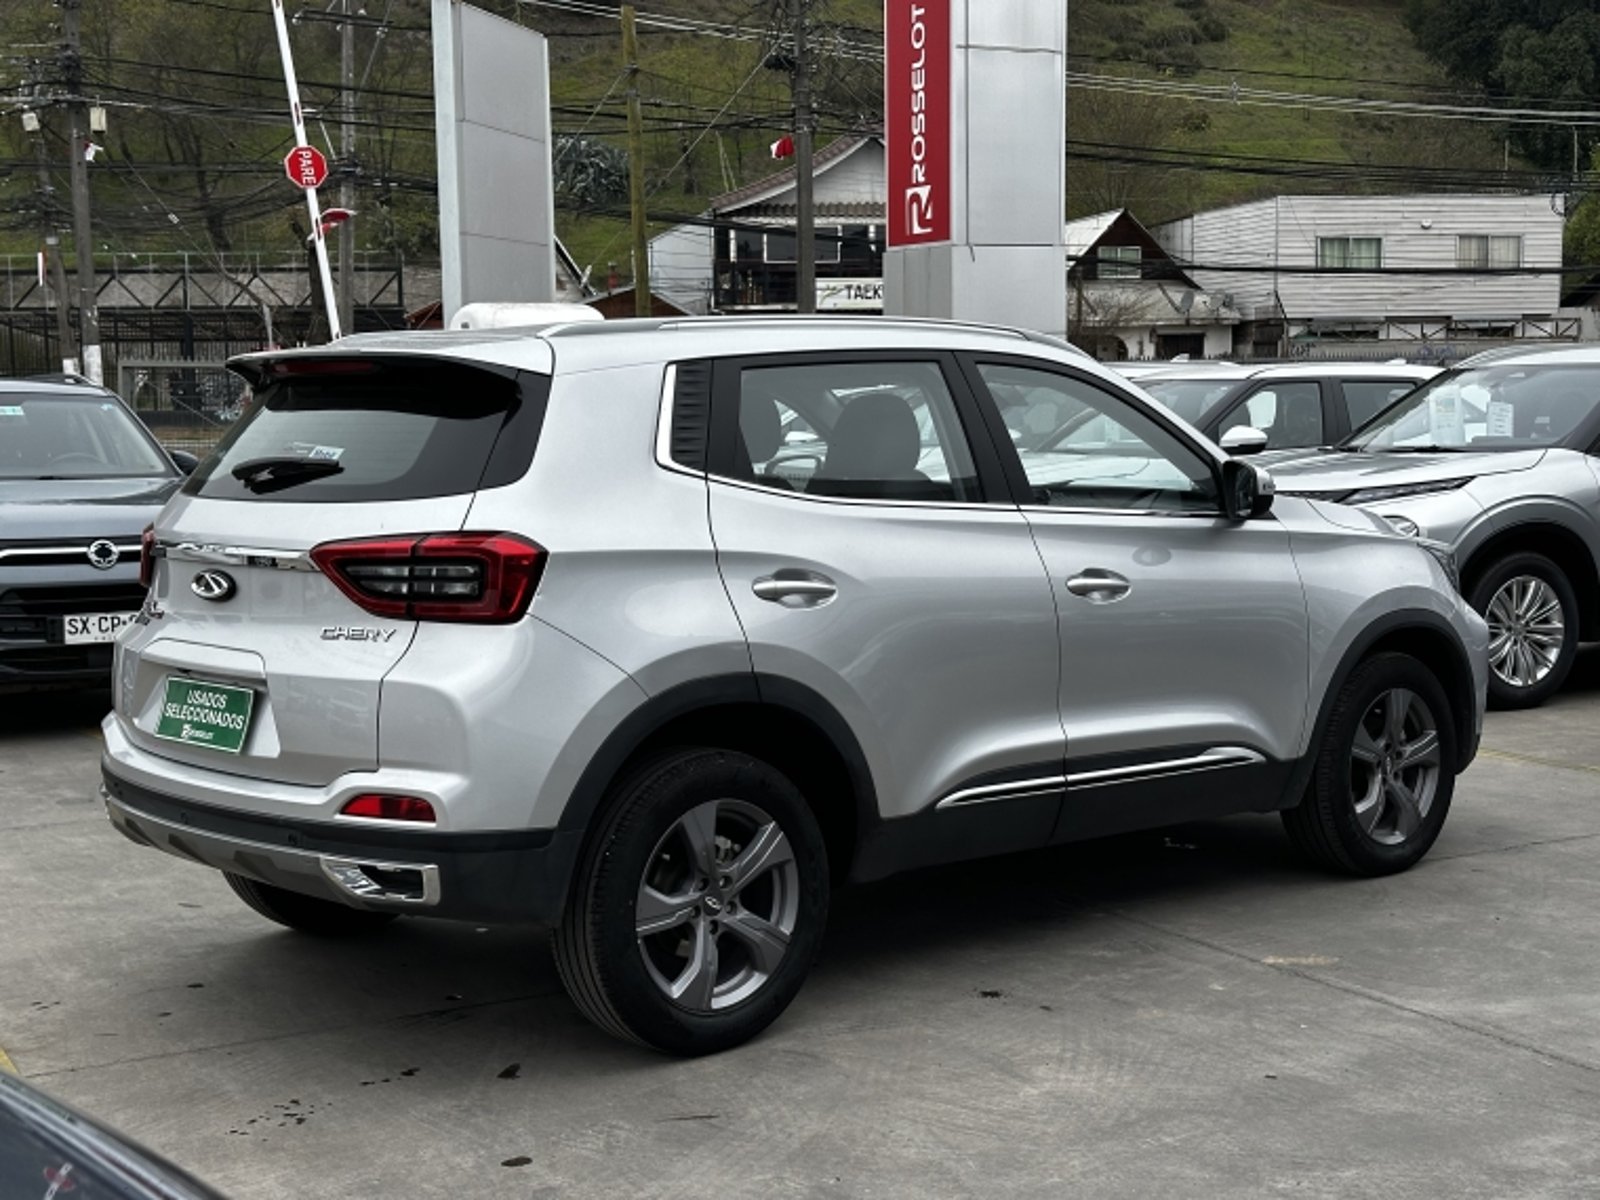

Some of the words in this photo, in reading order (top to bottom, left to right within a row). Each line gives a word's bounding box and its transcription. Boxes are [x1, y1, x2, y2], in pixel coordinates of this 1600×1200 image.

[911, 4, 926, 184] ROSSELOT
[297, 150, 317, 185] PARE
[844, 284, 883, 300] TAEK
[320, 626, 397, 642] CHERY
[187, 689, 228, 709] USADOS
[164, 702, 245, 730] SELECCIONADOS
